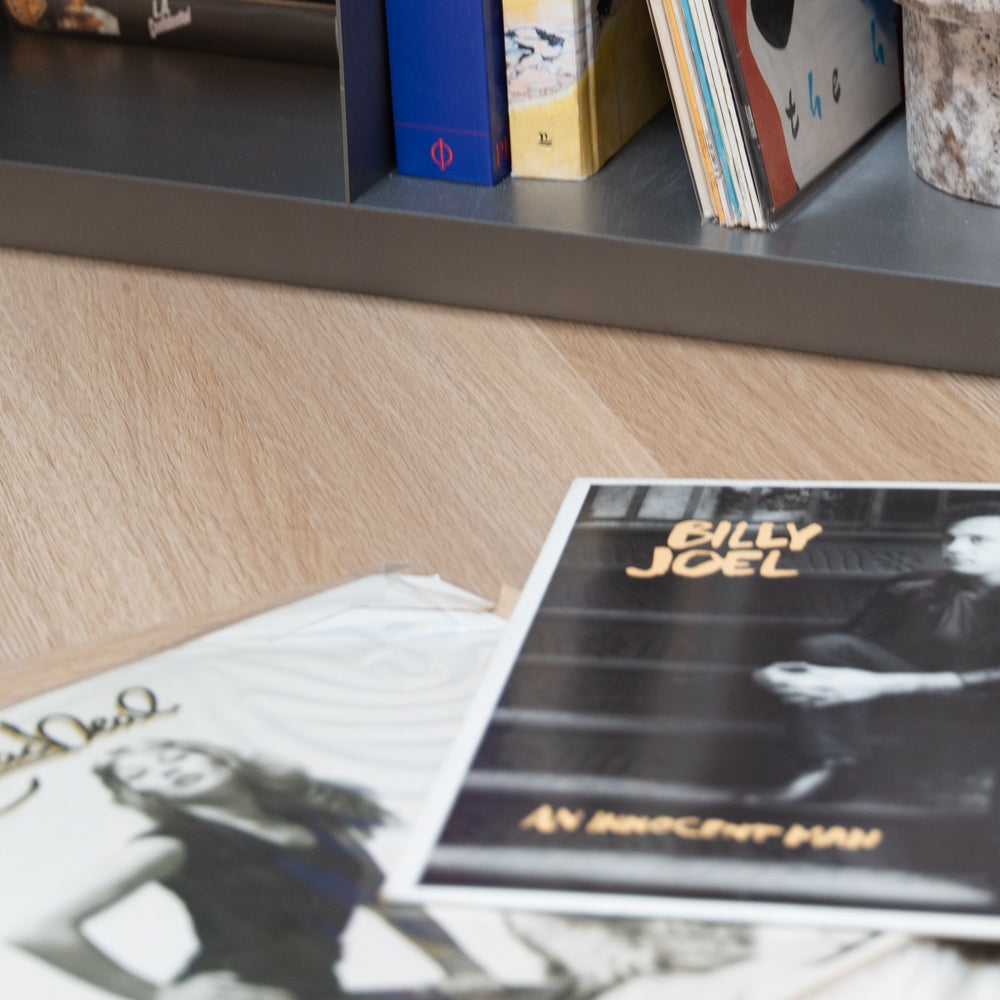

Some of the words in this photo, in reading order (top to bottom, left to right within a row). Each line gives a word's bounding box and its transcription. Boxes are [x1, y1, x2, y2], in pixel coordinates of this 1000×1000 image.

[785, 67, 841, 140] the
[668, 519, 824, 551] BILLY
[625, 545, 799, 578] JOEL
[519, 803, 585, 834] AN
[586, 810, 783, 844] INNOCENT
[782, 822, 884, 851] MAN
